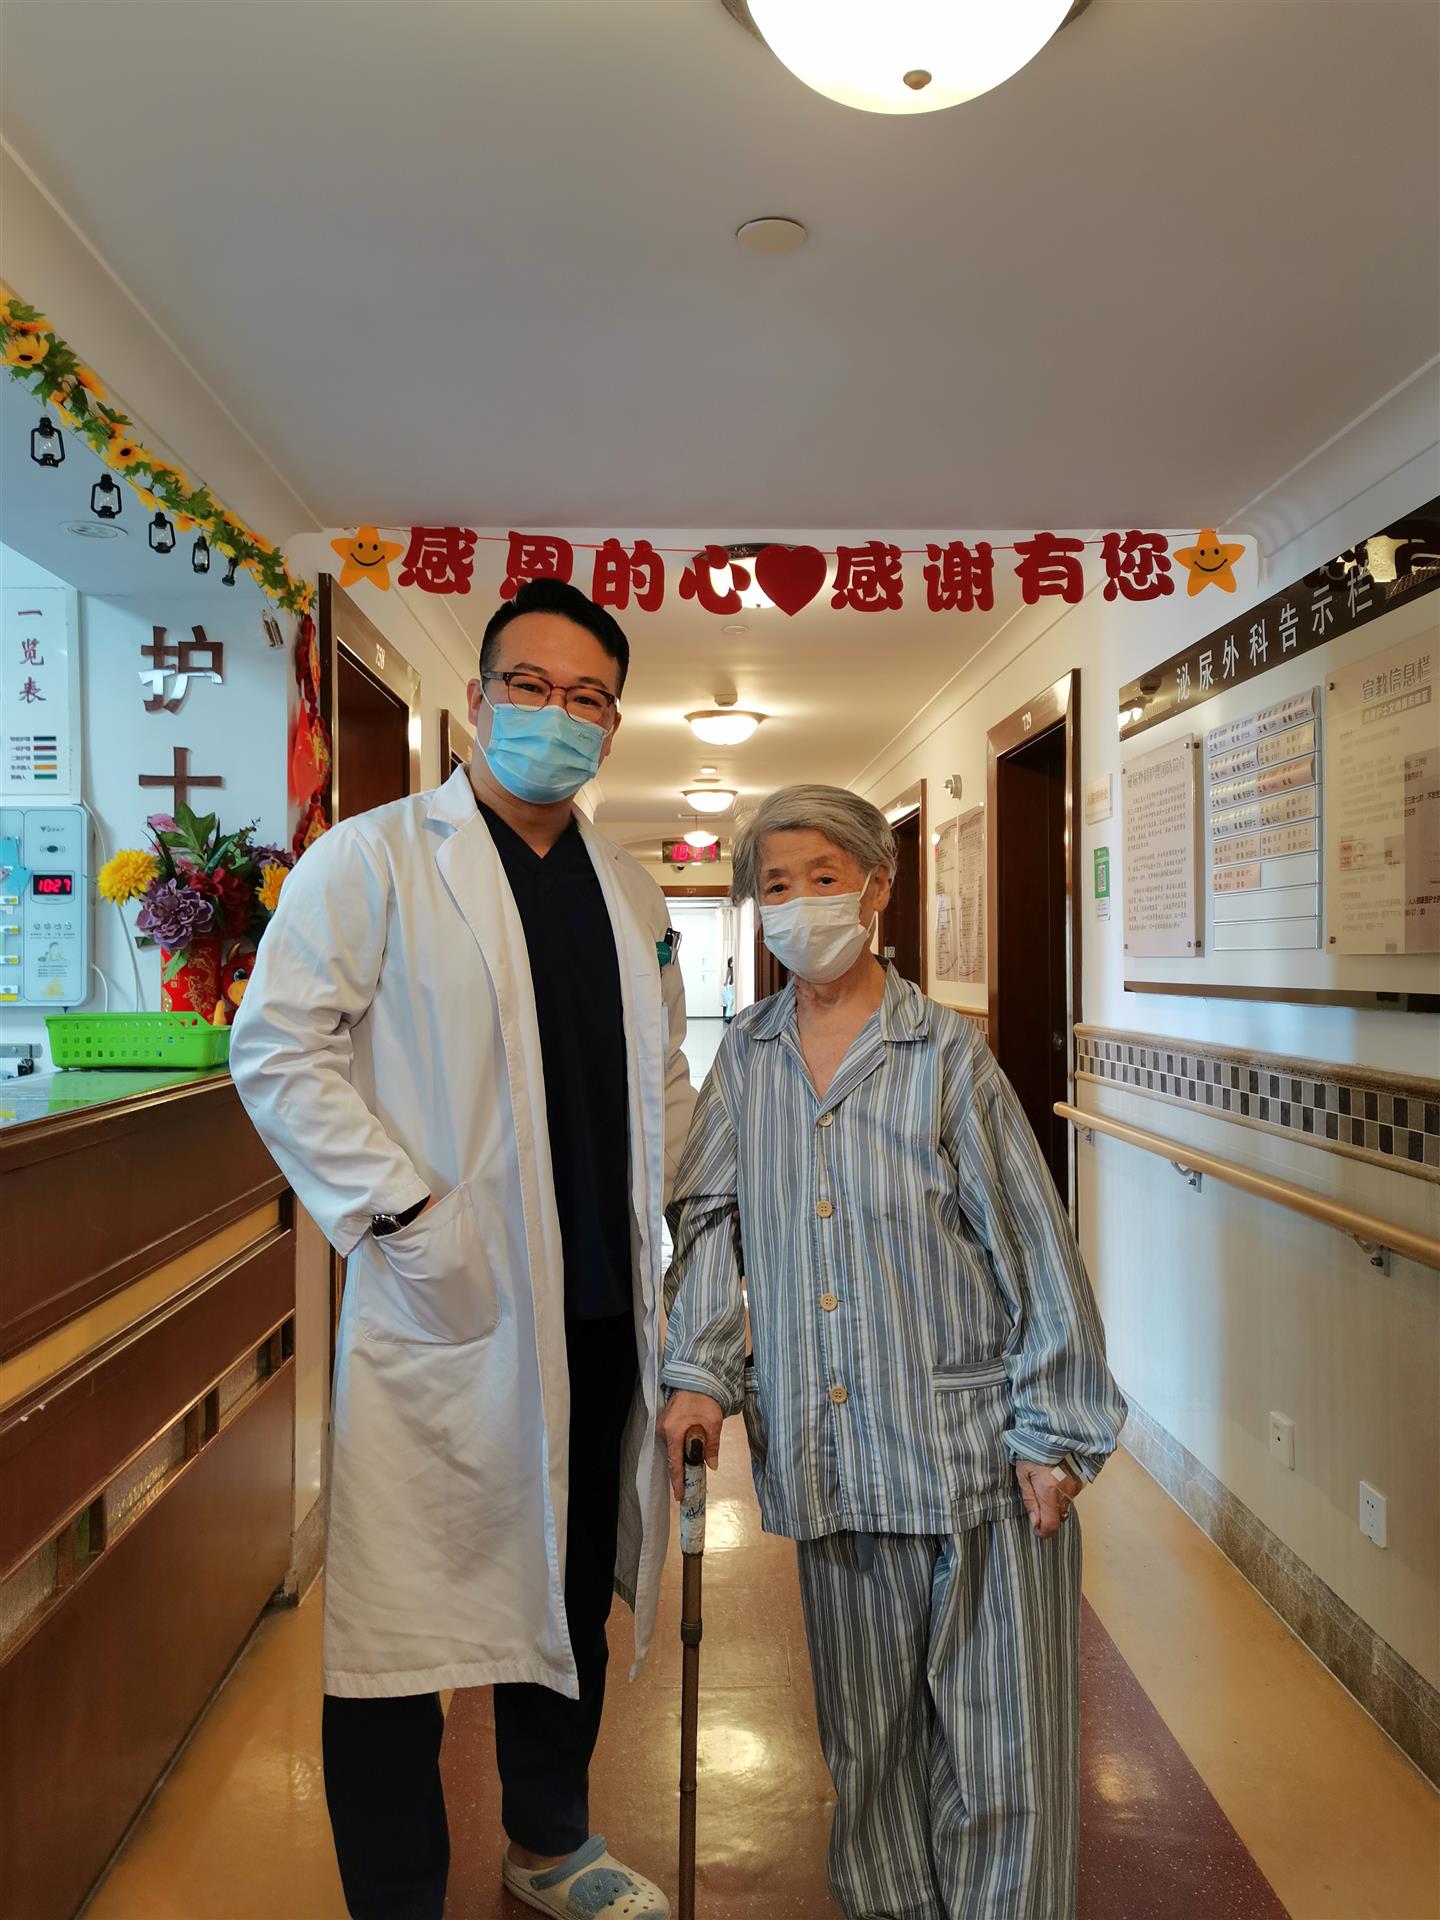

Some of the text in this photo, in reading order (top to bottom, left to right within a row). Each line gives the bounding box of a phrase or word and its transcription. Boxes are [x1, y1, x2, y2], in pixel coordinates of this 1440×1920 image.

[398, 527, 750, 615] 感恩的心
[831, 530, 1175, 612] 感谢有您
[17, 609, 47, 705] 一览表
[1176, 559, 1373, 704] 泌尿外科告示栏
[1362, 654, 1431, 703] 宣教信息栏
